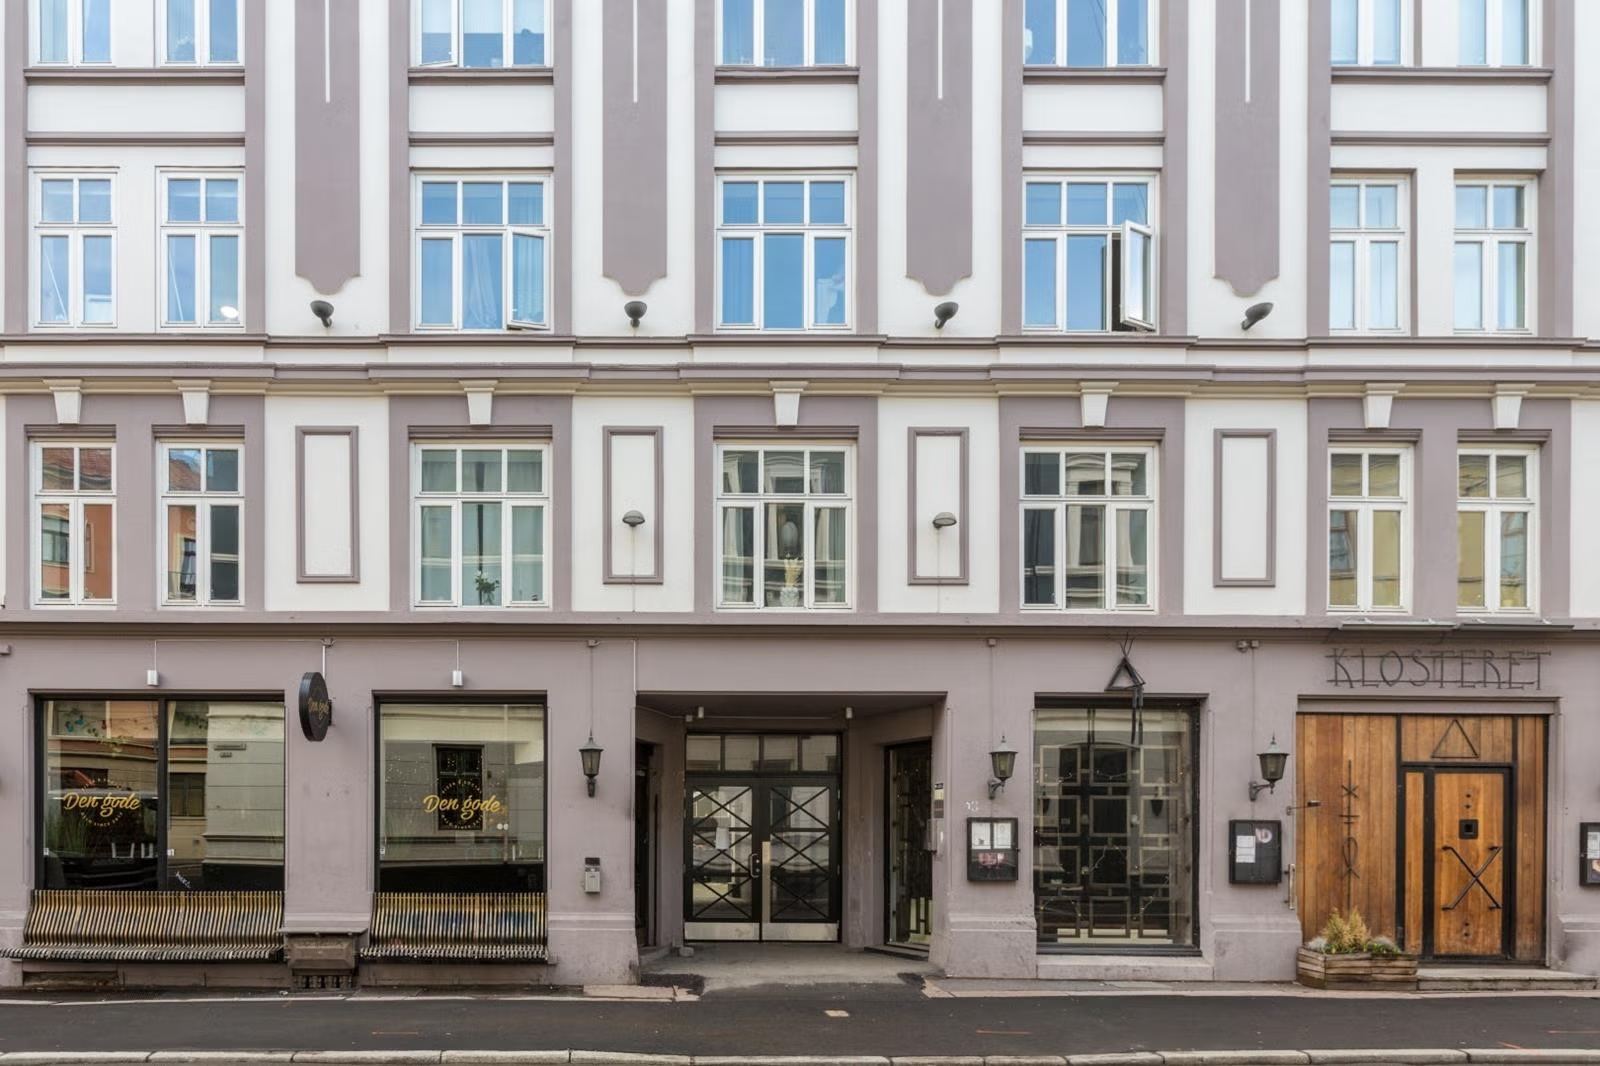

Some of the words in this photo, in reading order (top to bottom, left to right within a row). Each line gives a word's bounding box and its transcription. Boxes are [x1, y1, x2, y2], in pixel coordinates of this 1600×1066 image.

[1329, 648, 1551, 690] KLOSTERET
[63, 792, 98, 809] Den
[100, 792, 140, 817] gode
[423, 795, 459, 813] Den
[461, 795, 500, 820] gode
